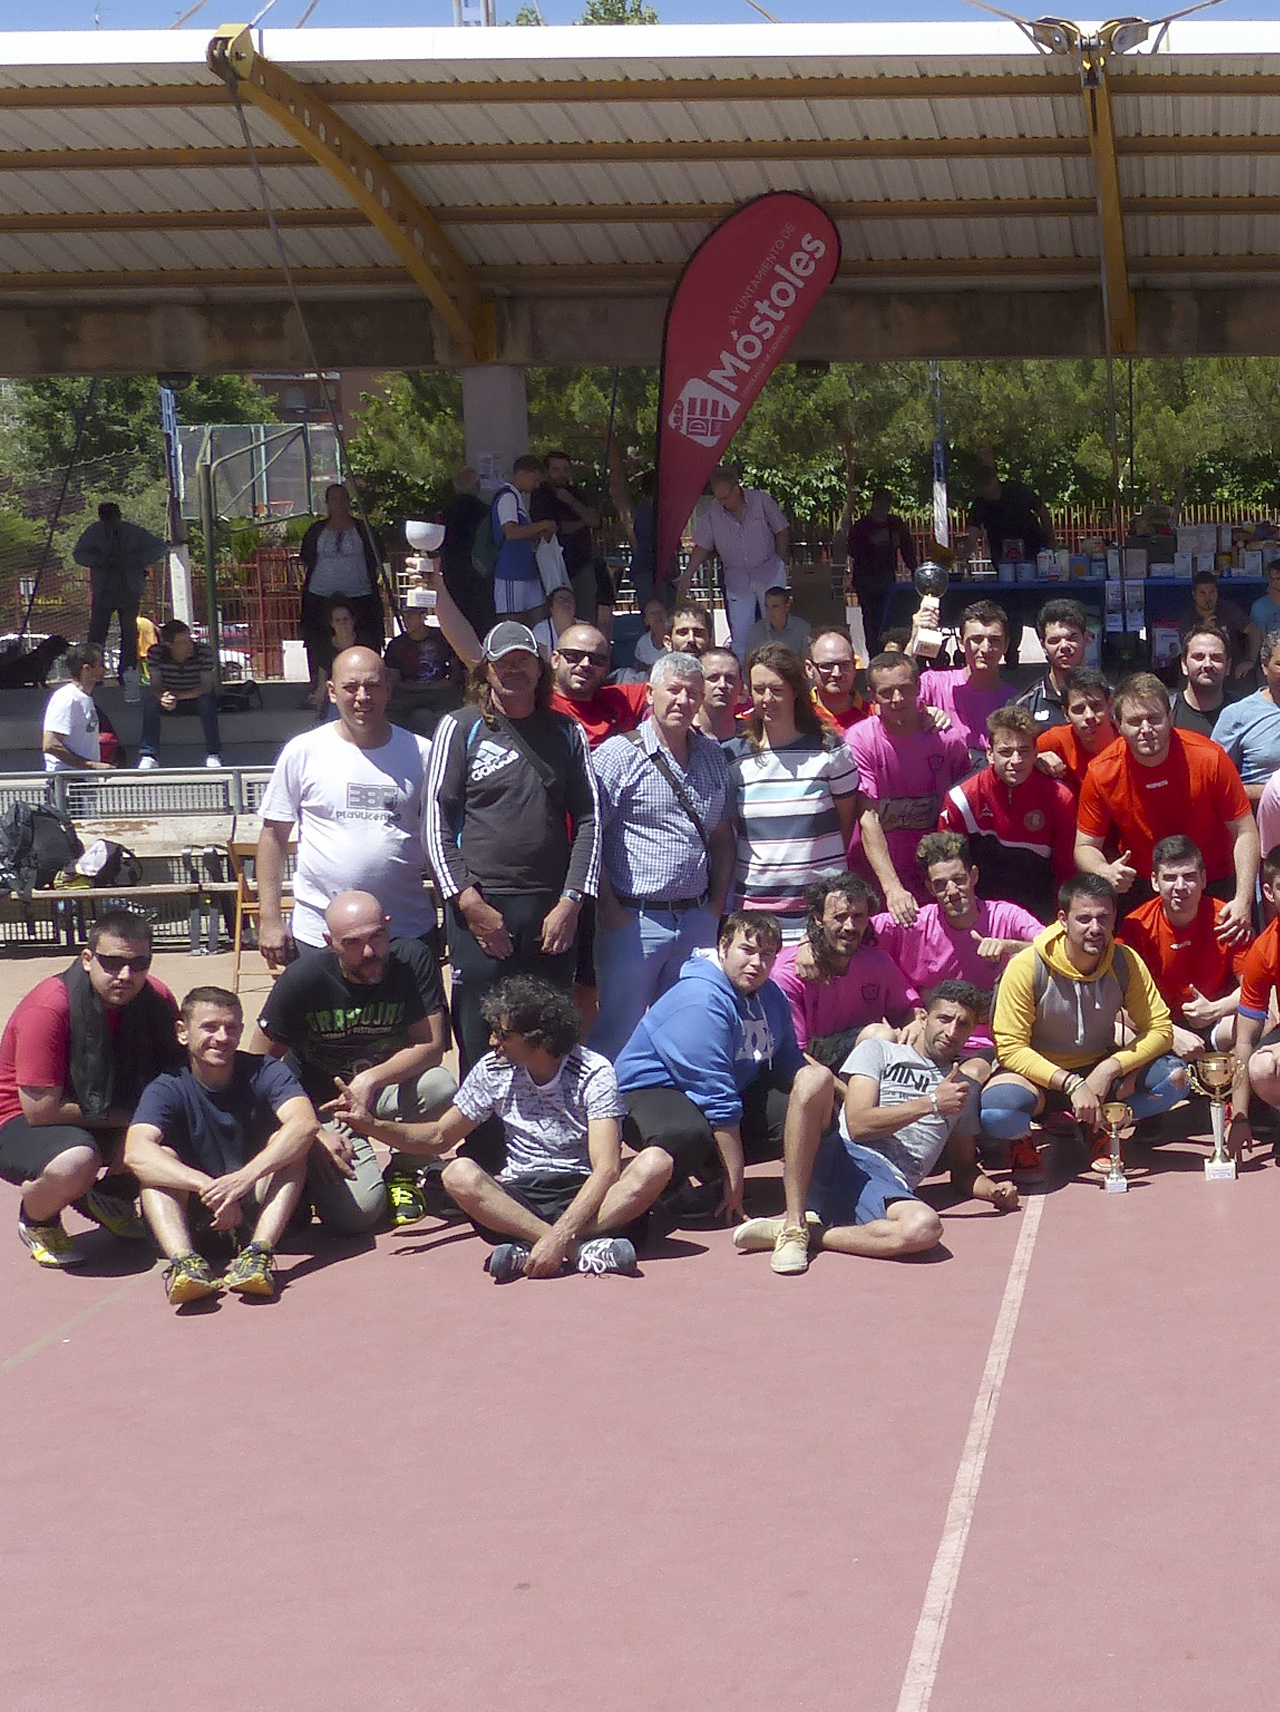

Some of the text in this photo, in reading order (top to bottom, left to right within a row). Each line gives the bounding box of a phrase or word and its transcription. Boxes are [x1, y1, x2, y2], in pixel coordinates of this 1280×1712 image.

[708, 233, 826, 391] Móstoles
[729, 222, 796, 325] AYUNTAMIENTO DE
[471, 750, 520, 781] adidas
